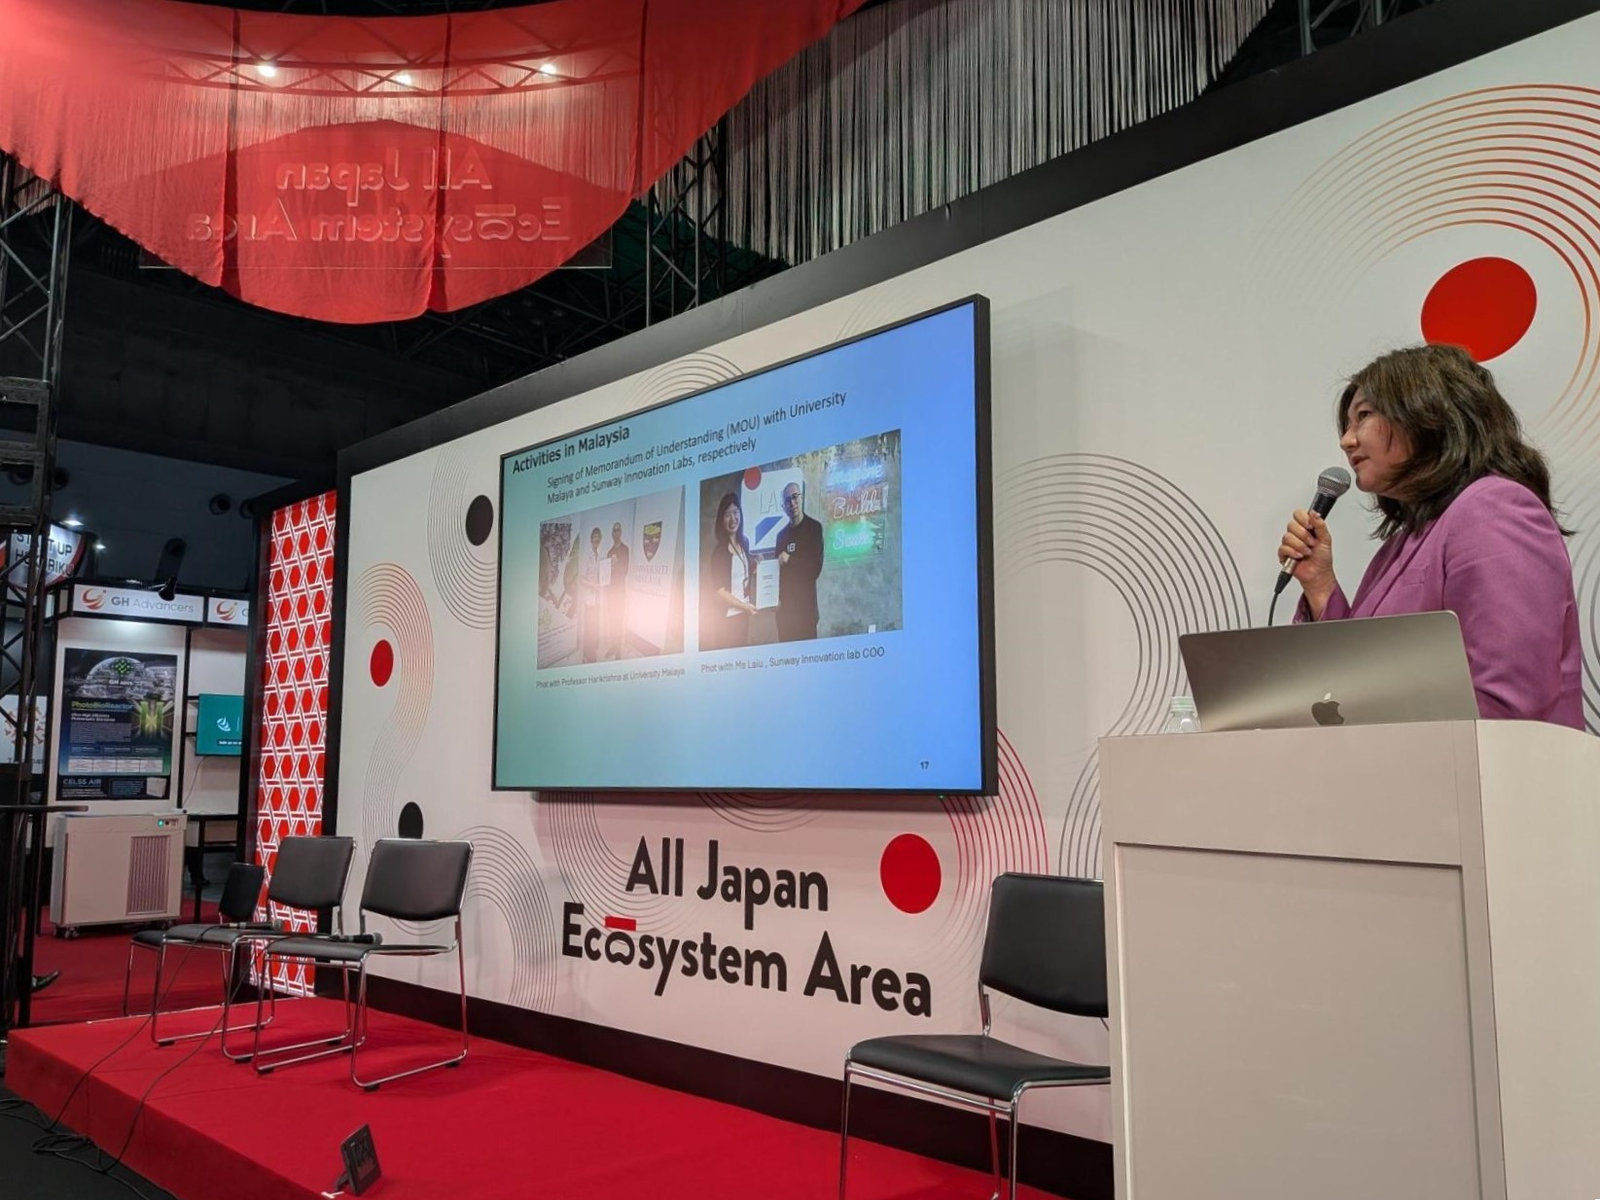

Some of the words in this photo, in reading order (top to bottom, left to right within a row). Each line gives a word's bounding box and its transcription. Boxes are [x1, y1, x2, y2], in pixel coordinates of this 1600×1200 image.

[513, 451, 561, 474] Activities
[564, 443, 575, 458] in
[578, 426, 630, 453] Malaysia
[547, 472, 573, 489] Signing
[575, 466, 585, 480] of
[585, 451, 643, 477] Memorandum
[645, 446, 655, 459] of
[656, 428, 724, 453] Understanding
[727, 414, 760, 439] (MOU)
[763, 408, 787, 426] with
[790, 391, 847, 418] University
[547, 488, 574, 504] Malaya
[575, 482, 590, 495] and
[591, 475, 622, 493] Sunway
[624, 460, 670, 482] Innovation
[672, 455, 696, 471] Labs,
[698, 437, 757, 463] respectively
[16, 534, 54, 553] STT
[57, 542, 72, 557] UP
[15, 548, 75, 576] HRIKU
[111, 596, 130, 607] GH
[132, 597, 194, 613] Advancers
[700, 663, 717, 673] Phot
[718, 662, 734, 671] with
[769, 656, 800, 668] Sunway
[801, 651, 845, 664] Innovation
[847, 648, 861, 660] lab
[863, 646, 885, 658] COO
[561, 676, 588, 687] Professor
[630, 669, 660, 681] University
[920, 761, 929, 770] 17
[625, 835, 685, 897] All
[697, 839, 829, 931] Japan
[803, 930, 932, 1018] Area
